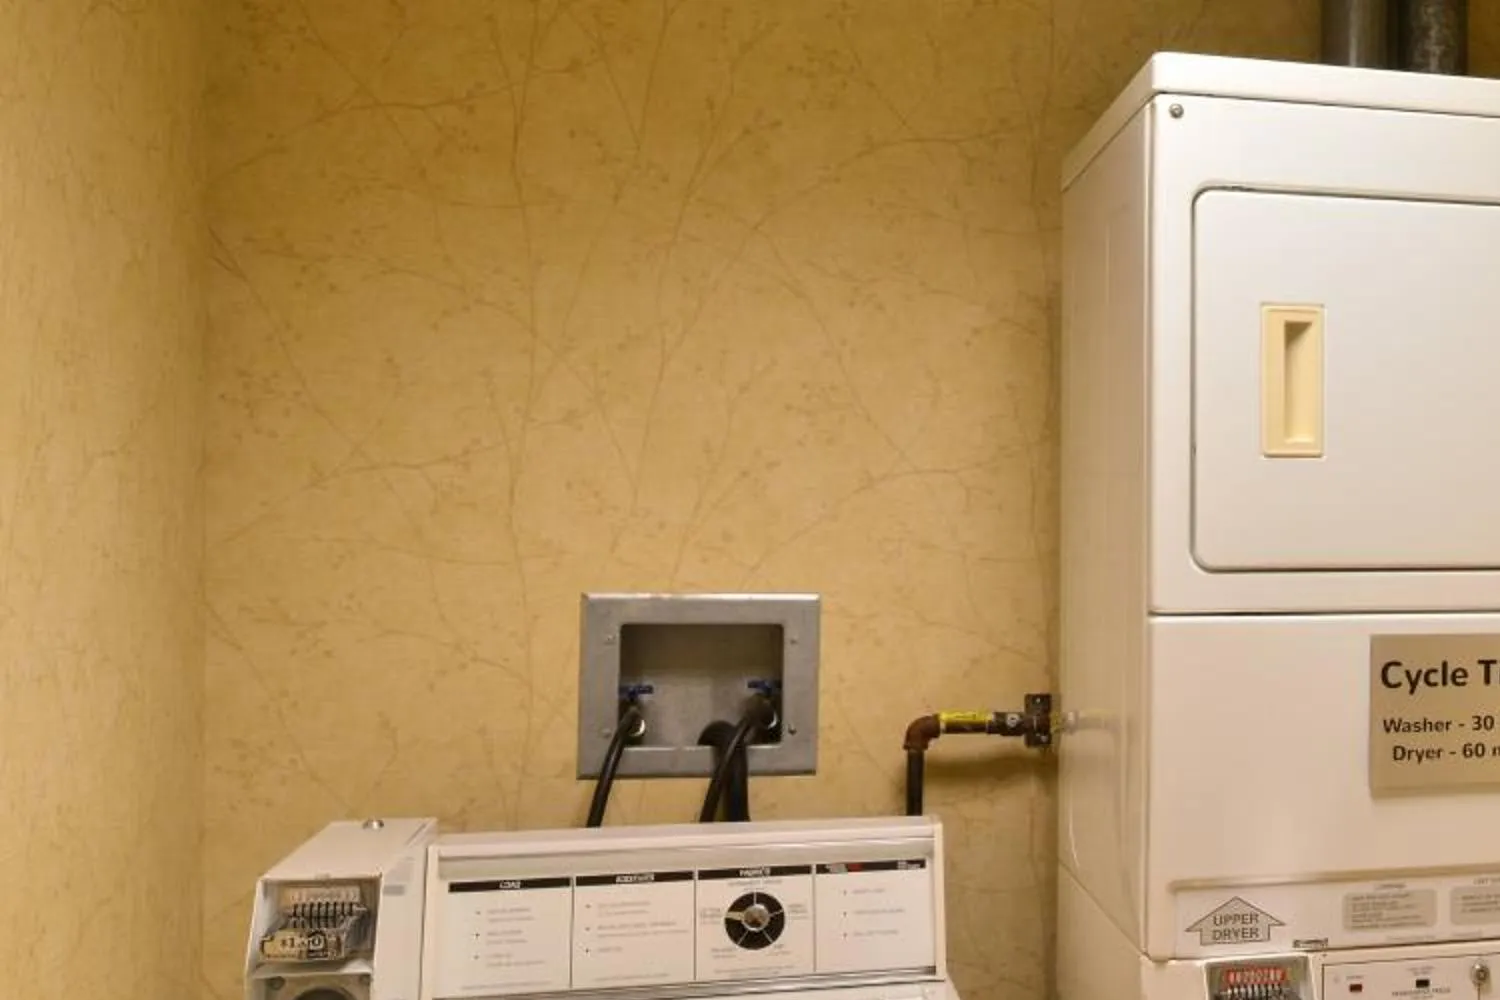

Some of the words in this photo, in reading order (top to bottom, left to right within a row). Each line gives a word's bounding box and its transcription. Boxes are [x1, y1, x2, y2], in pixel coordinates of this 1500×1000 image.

[1380, 660, 1469, 695] Cycle
[1383, 717, 1452, 734] Washer
[1471, 715, 1495, 731] 30
[1392, 744, 1444, 765] Dryer
[1462, 742, 1486, 758] 60
[1213, 913, 1259, 927] UPPER
[1212, 927, 1260, 941] DRYER
